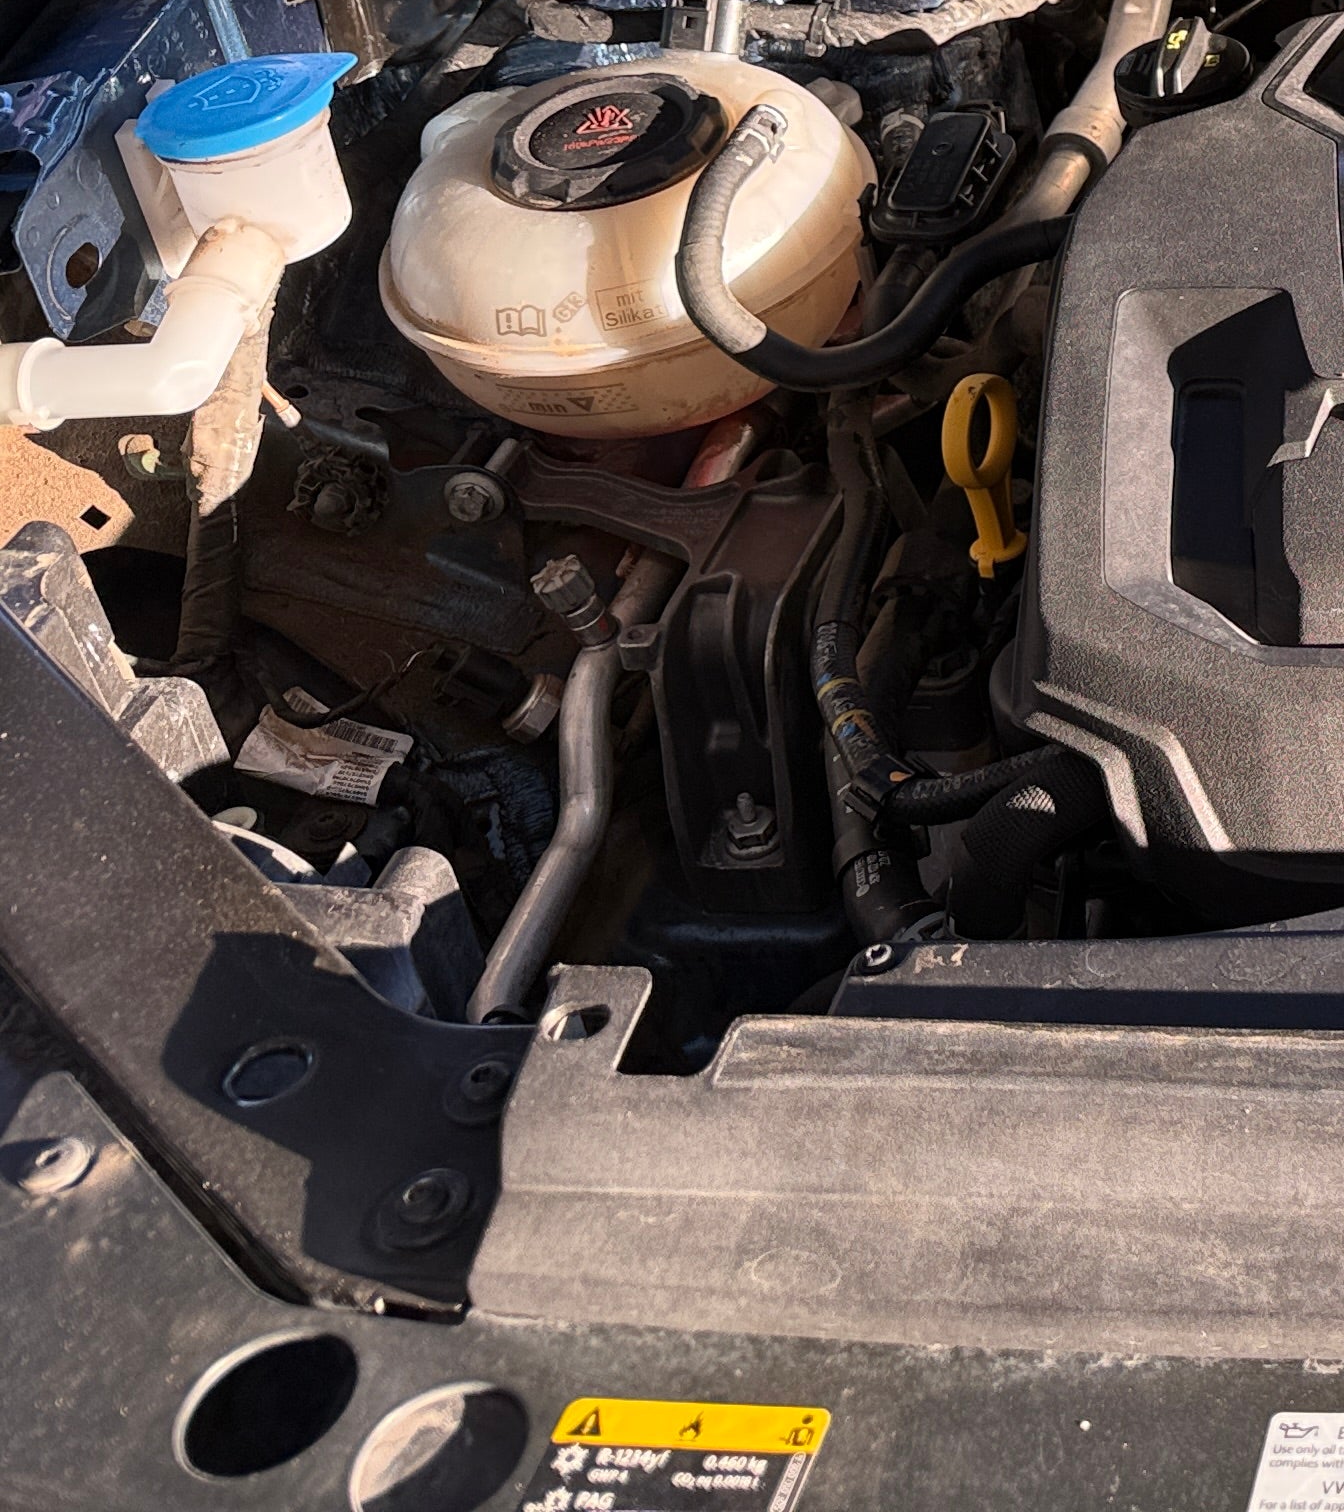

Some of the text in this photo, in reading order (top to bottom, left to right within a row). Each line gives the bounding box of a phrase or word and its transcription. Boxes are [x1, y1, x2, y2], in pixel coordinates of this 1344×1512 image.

[616, 289, 645, 308] mit
[605, 303, 665, 327] Silikat
[528, 402, 568, 414] min
[1272, 1443, 1295, 1455] Use
[1295, 1445, 1320, 1457] only
[1322, 1445, 1336, 1456] oil
[595, 1448, 672, 1474] R-1234yf
[747, 1456, 768, 1476] kg
[1269, 1457, 1319, 1470] complies
[574, 1491, 616, 1511] PAG
[1259, 1500, 1277, 1511] For
[1280, 1503, 1288, 1511] a
[1289, 1500, 1308, 1511] list
[1309, 1500, 1323, 1511] of
